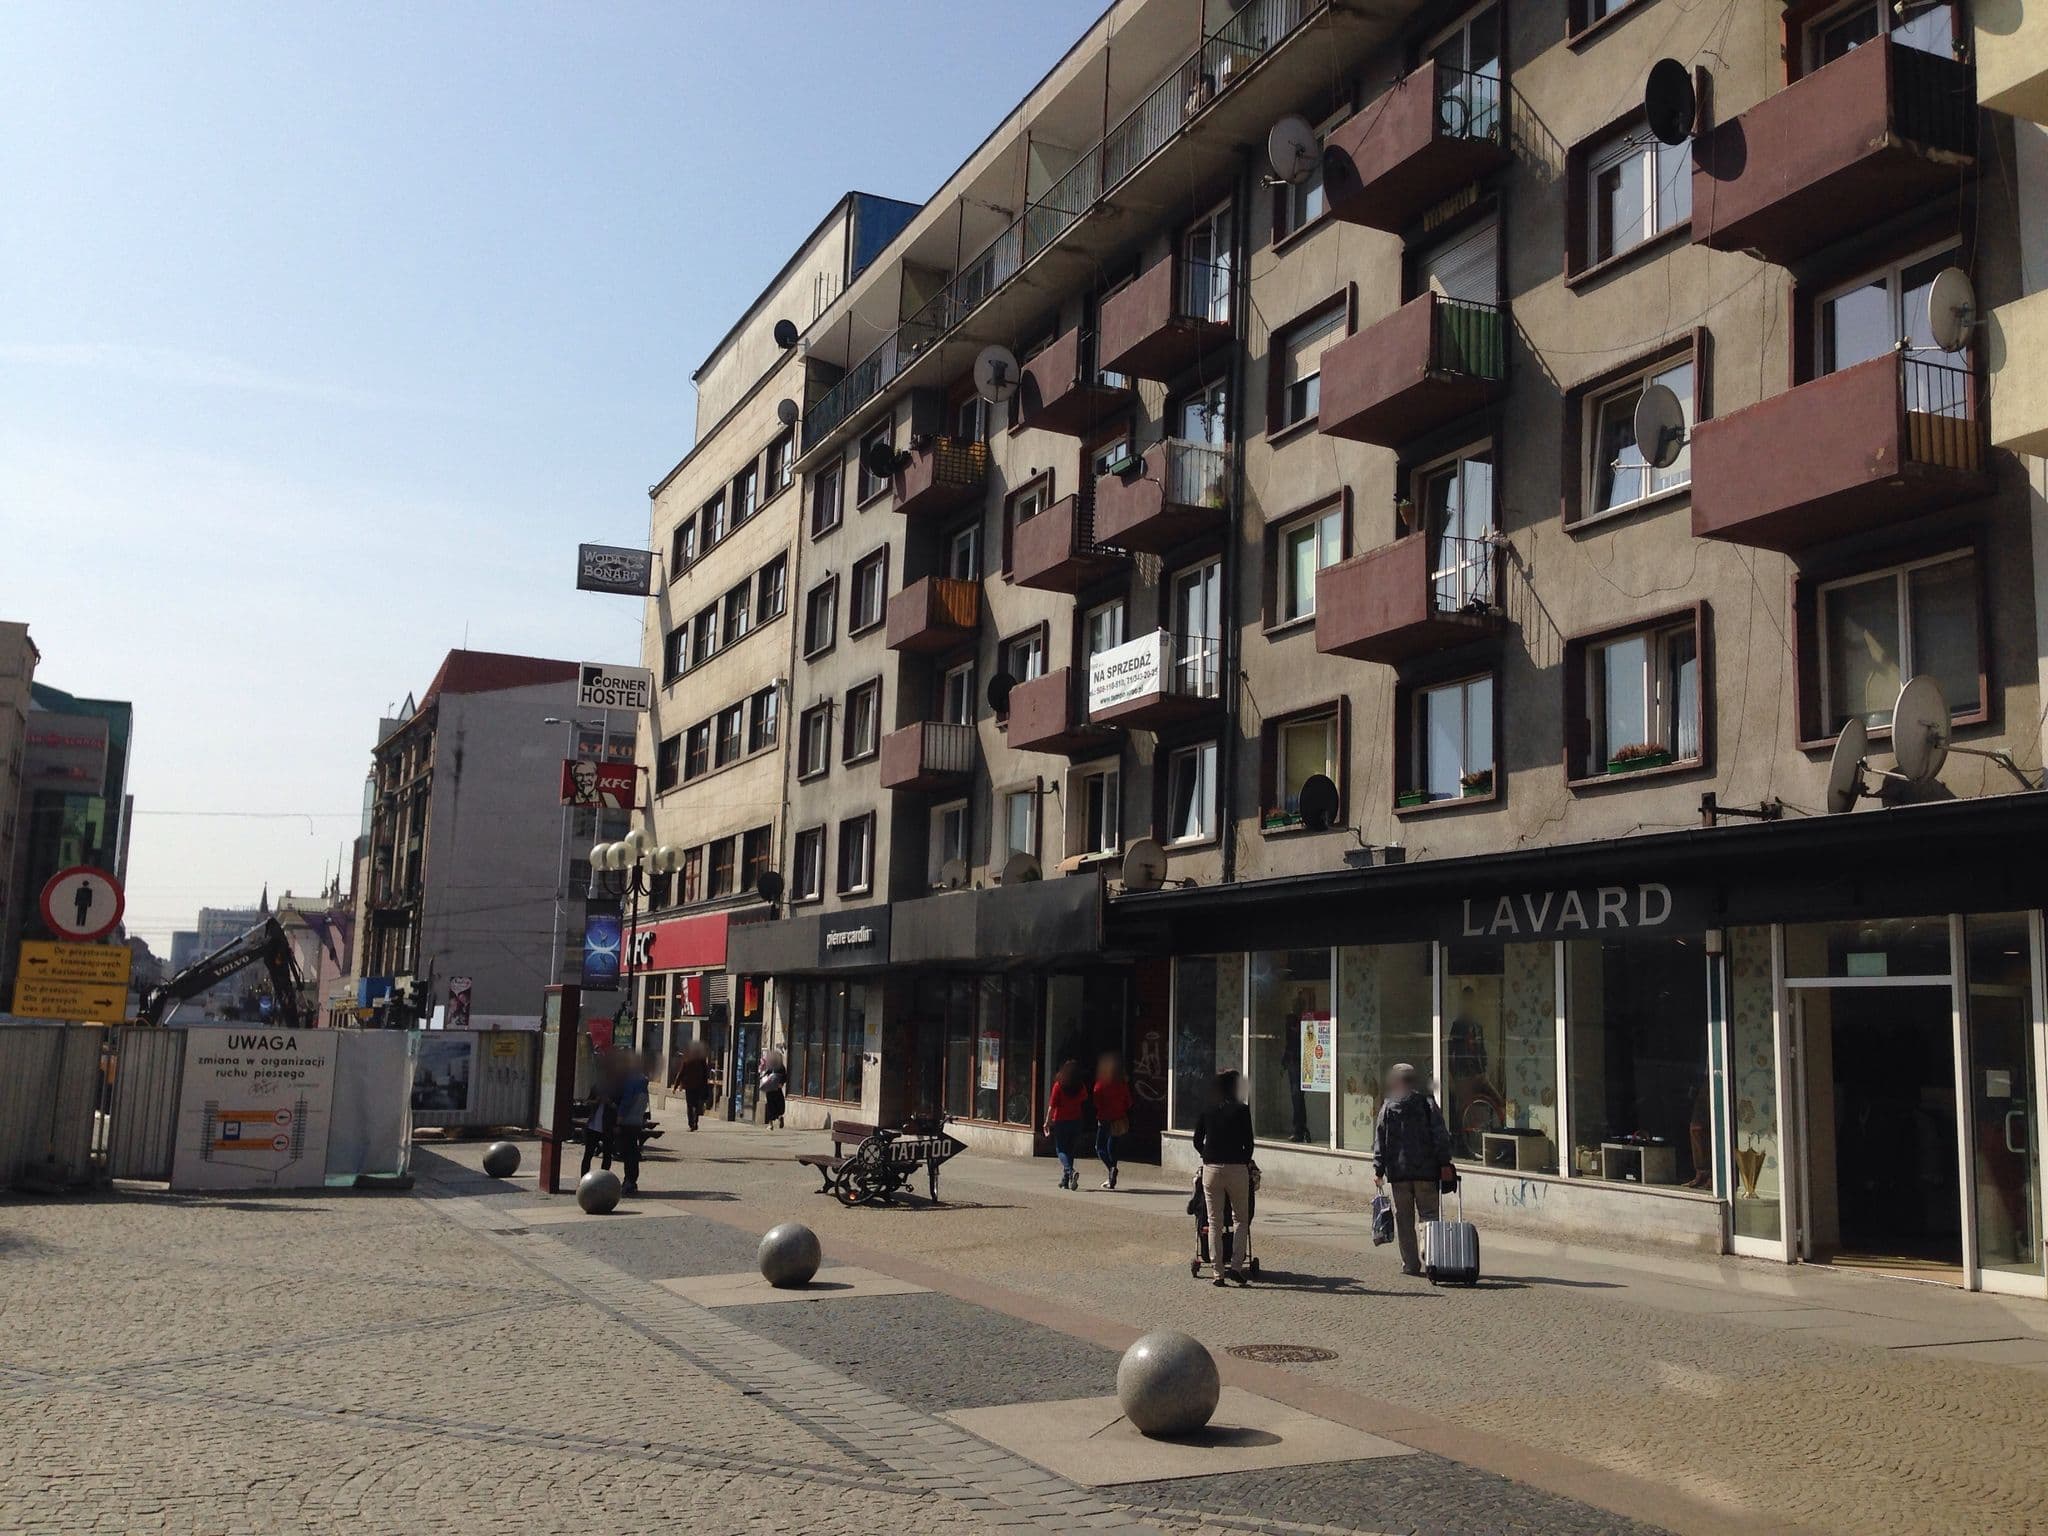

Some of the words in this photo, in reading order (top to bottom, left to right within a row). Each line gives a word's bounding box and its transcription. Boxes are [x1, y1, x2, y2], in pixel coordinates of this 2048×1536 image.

[584, 565, 640, 581] BONART
[1093, 670, 1105, 684] NA
[1106, 650, 1151, 679] SPRZEDAŻ
[592, 675, 647, 691] CORNER
[581, 687, 646, 708] HOSTEL
[599, 777, 632, 790] KFC
[1462, 883, 1672, 937] LAVARD
[826, 930, 847, 950] pierre
[847, 925, 873, 944] cardin
[213, 955, 250, 977] VOLVO
[228, 1035, 298, 1050] UWAGA
[198, 1055, 240, 1066] zmiana
[246, 1058, 255, 1067] w
[261, 1056, 325, 1069] organizacji
[215, 1068, 248, 1078] ruchu
[253, 1069, 305, 1081] pieszego
[888, 1139, 952, 1161] TATTOO
